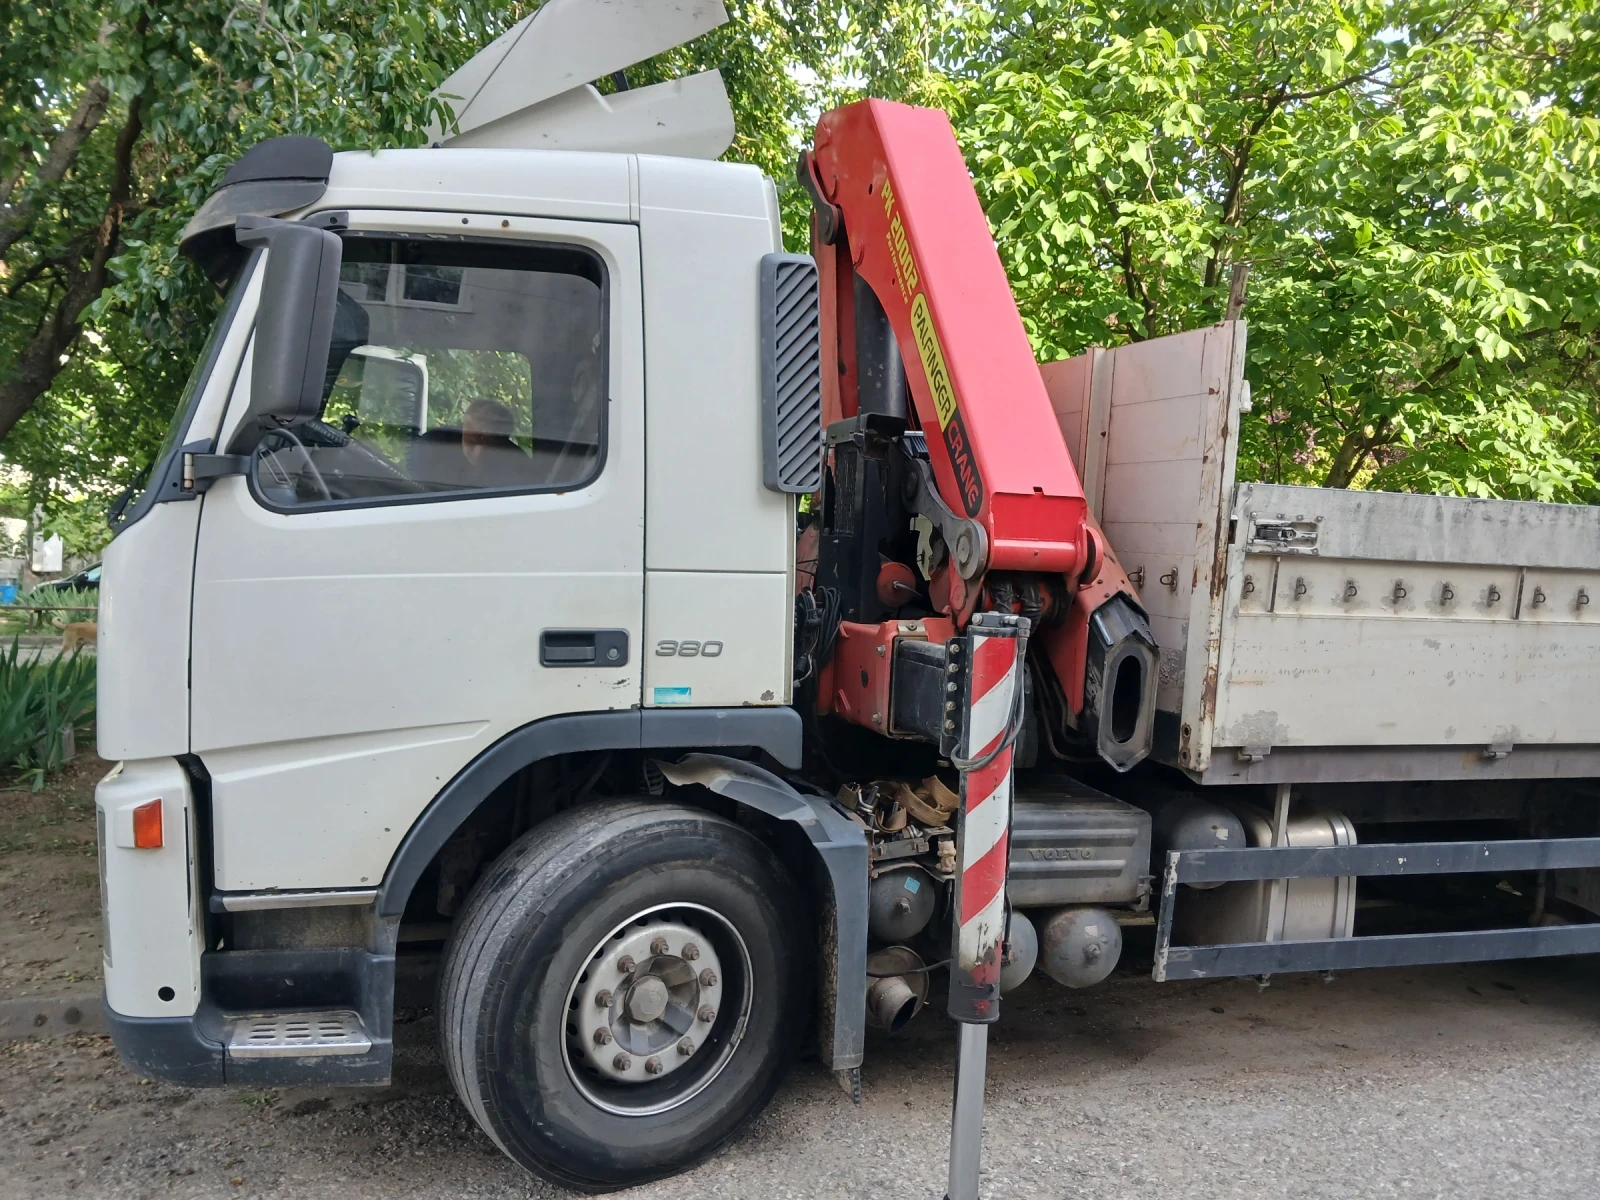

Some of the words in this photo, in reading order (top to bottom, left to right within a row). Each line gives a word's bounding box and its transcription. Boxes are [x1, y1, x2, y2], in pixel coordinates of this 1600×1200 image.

[881, 178, 895, 220] PK
[890, 210, 918, 296] 20002
[885, 231, 909, 305] Performance
[913, 302, 952, 421] PALFINGER
[947, 419, 979, 508] CRANE
[655, 640, 724, 657] 380
[1028, 847, 1094, 860] VOLVO
